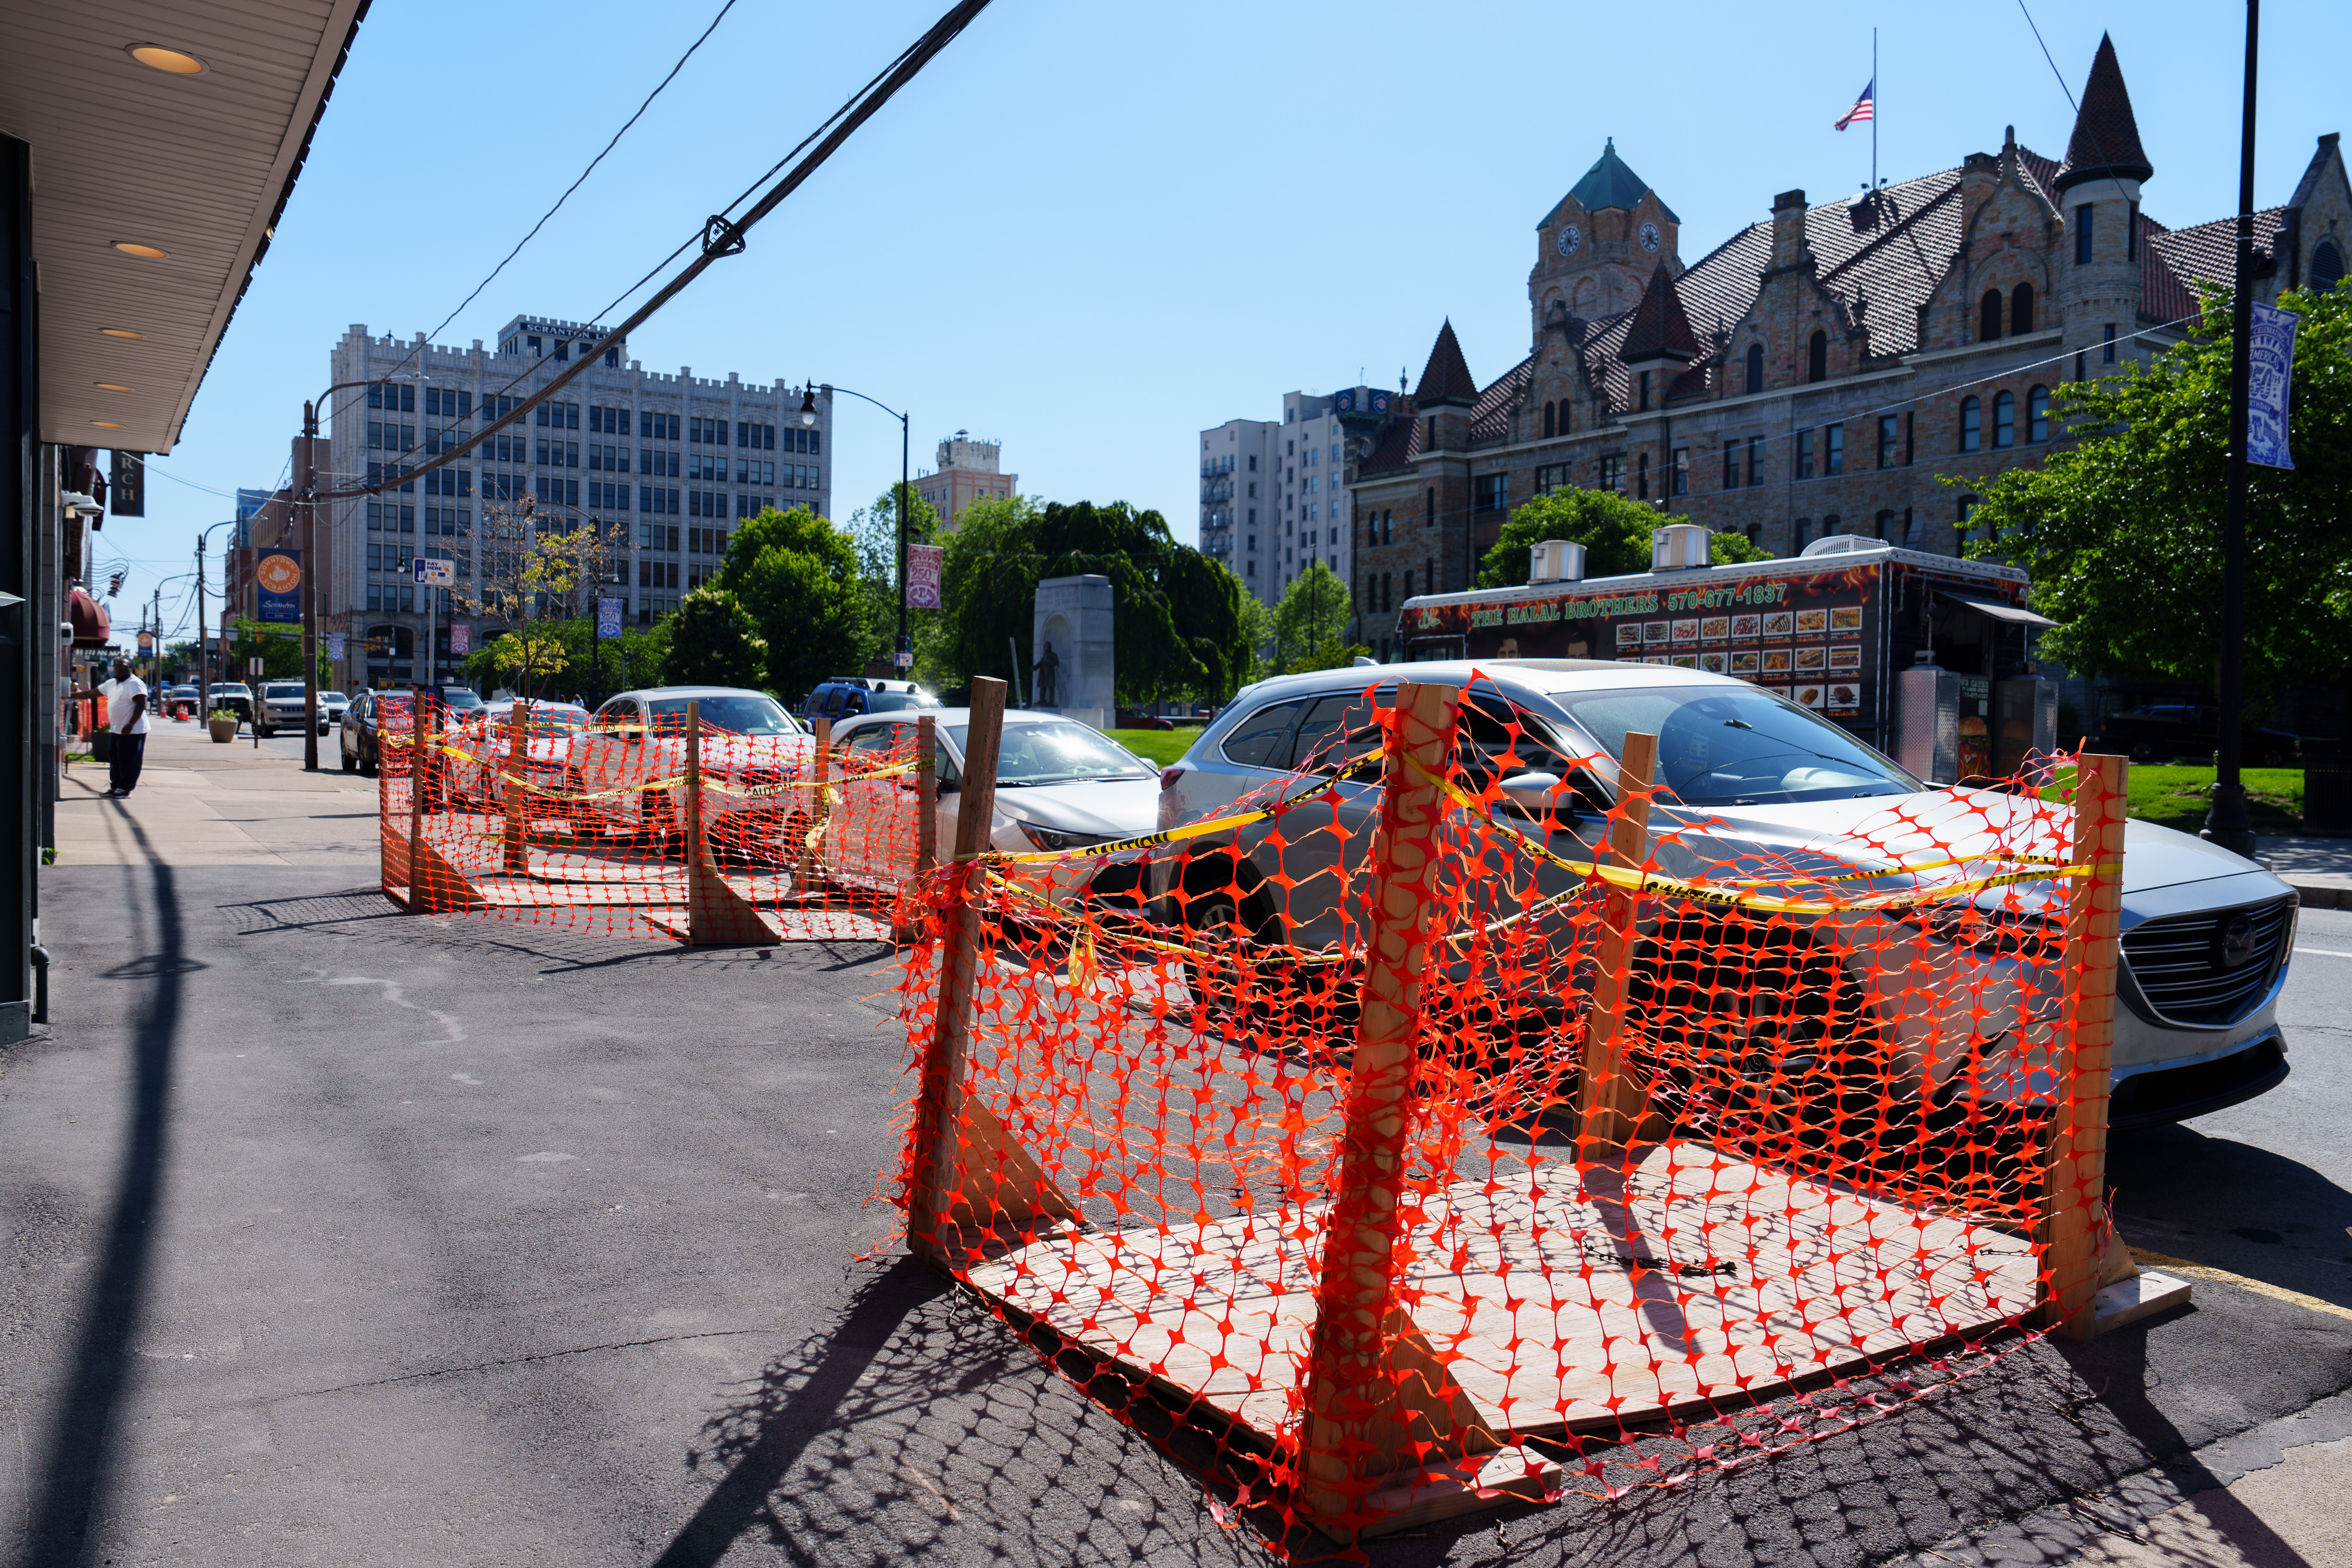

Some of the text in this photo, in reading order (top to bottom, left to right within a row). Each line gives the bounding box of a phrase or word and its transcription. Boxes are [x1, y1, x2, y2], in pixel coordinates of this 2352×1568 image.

[526, 324, 589, 339] SCRANTON
[2254, 326, 2285, 342] CELEBRATING
[2249, 400, 2272, 412] RTHDAY
[261, 557, 295, 574] DOWNTOWN
[263, 573, 298, 591] SCRANTON
[262, 600, 295, 609] Scranton
[1471, 583, 1787, 627] THE HALAL BROTHERS 570-677-1837
[1971, 679, 1989, 688] CATER
